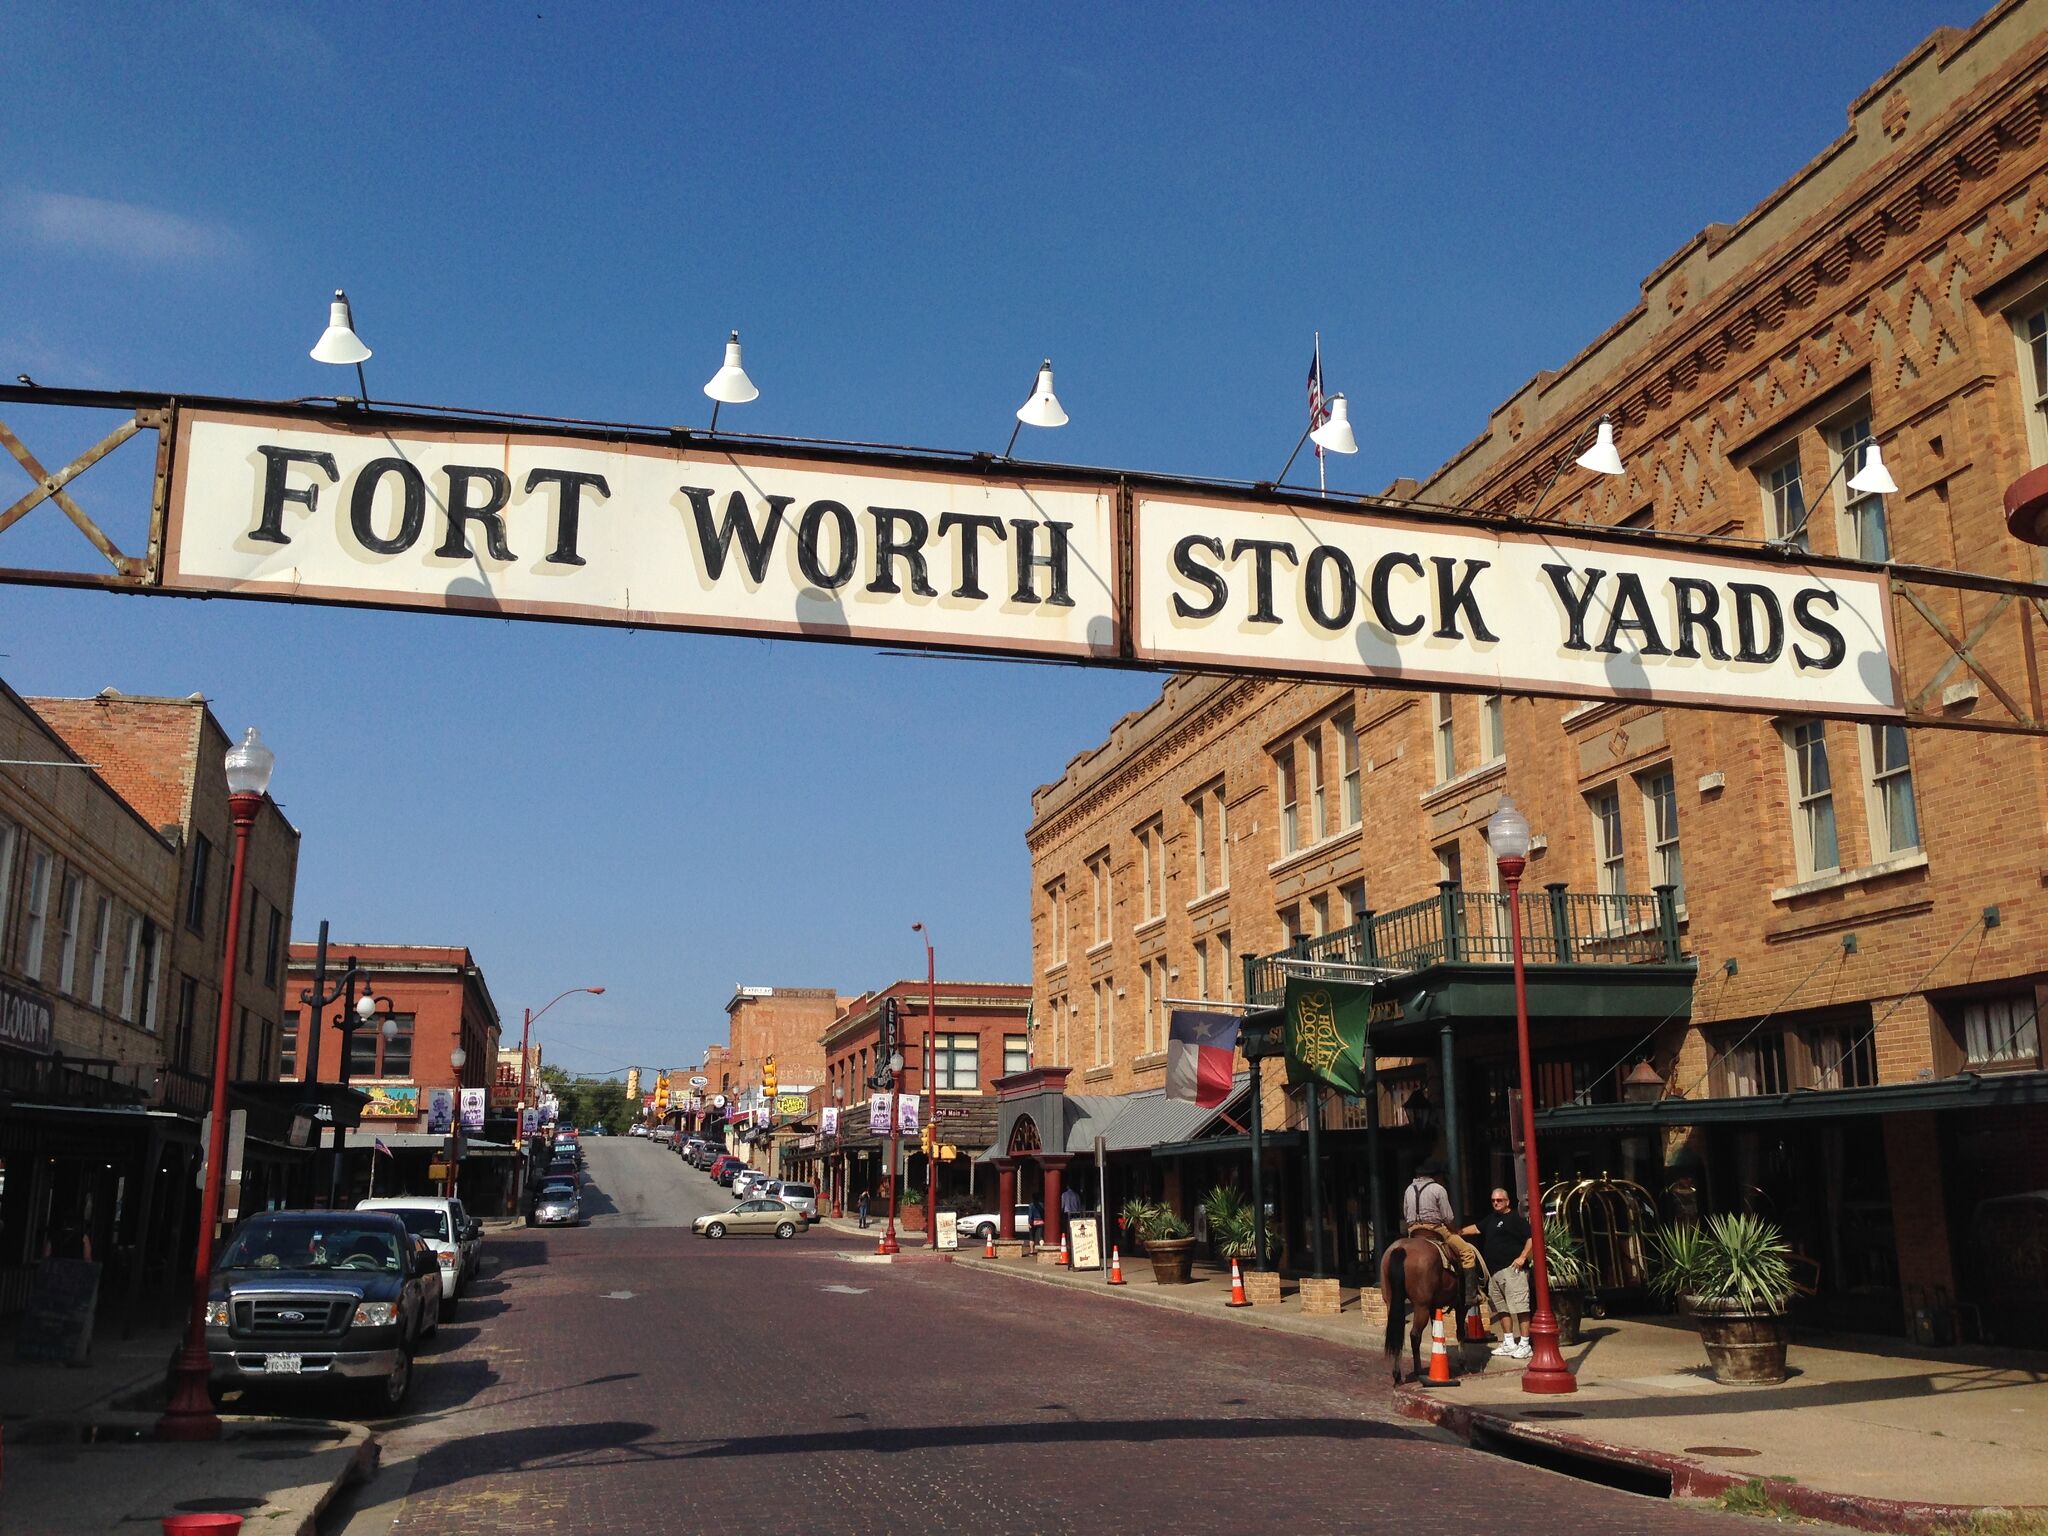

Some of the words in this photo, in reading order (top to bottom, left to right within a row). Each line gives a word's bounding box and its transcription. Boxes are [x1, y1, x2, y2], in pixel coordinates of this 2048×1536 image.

[248, 444, 611, 566] FORT
[680, 485, 1076, 608] WORTH
[1171, 533, 1500, 643] STOCK
[1541, 562, 1847, 671] YARDS
[0, 990, 39, 1043] LOON
